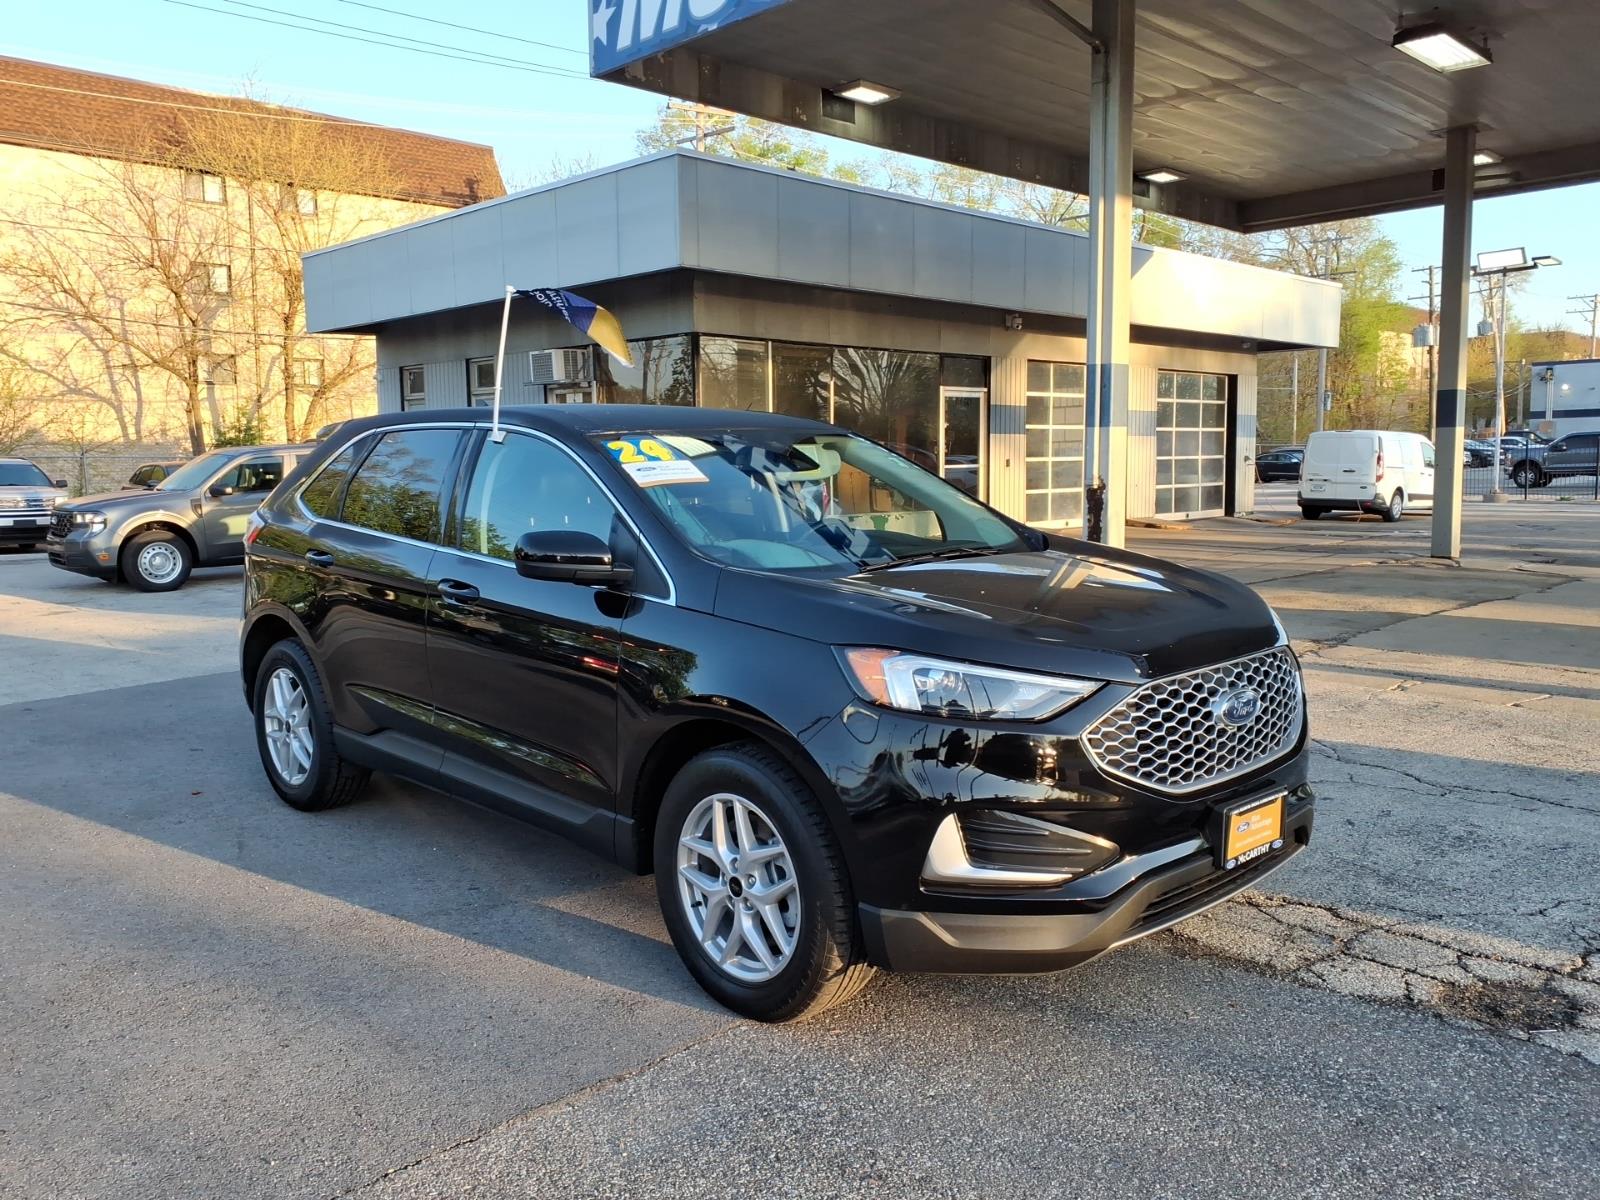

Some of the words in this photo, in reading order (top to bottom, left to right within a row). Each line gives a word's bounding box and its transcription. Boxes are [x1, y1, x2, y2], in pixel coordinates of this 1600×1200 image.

[607, 439, 673, 464] 24
[1233, 697, 1255, 718] Ford
[1238, 843, 1271, 865] McCARTHY
